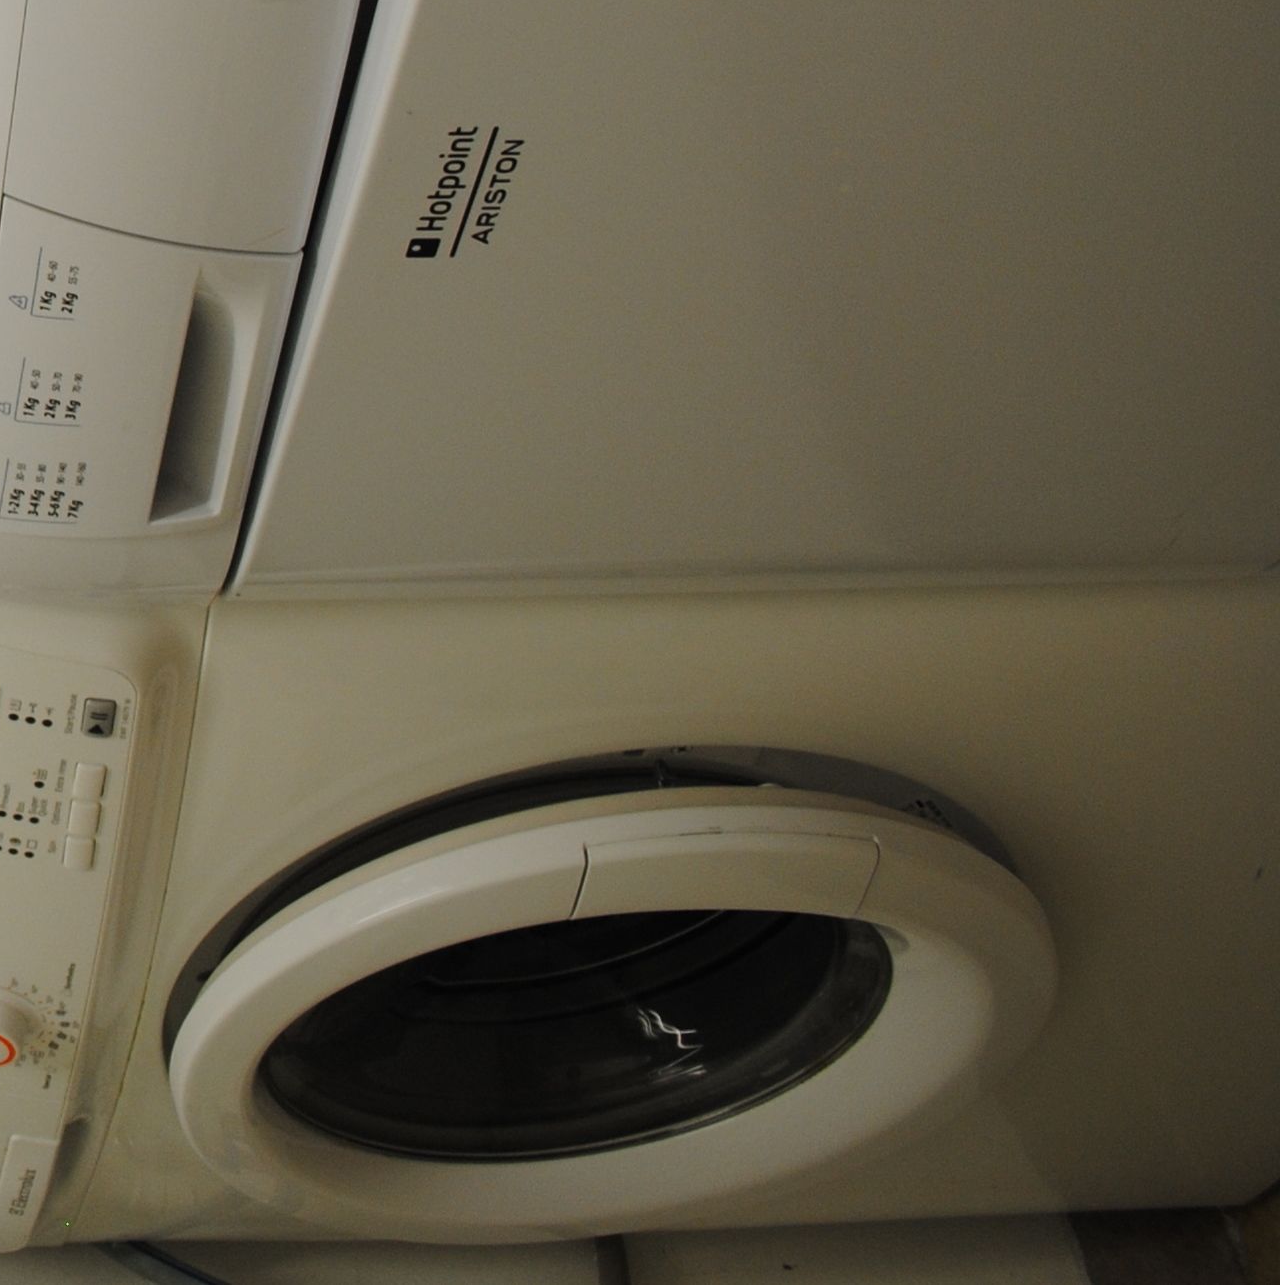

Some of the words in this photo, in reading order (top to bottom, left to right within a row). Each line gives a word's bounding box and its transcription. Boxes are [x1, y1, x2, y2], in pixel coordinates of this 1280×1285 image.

[416, 125, 479, 232] Hotpoint
[471, 138, 525, 246] ARISTON
[11, 1167, 38, 1208] Electrolux
